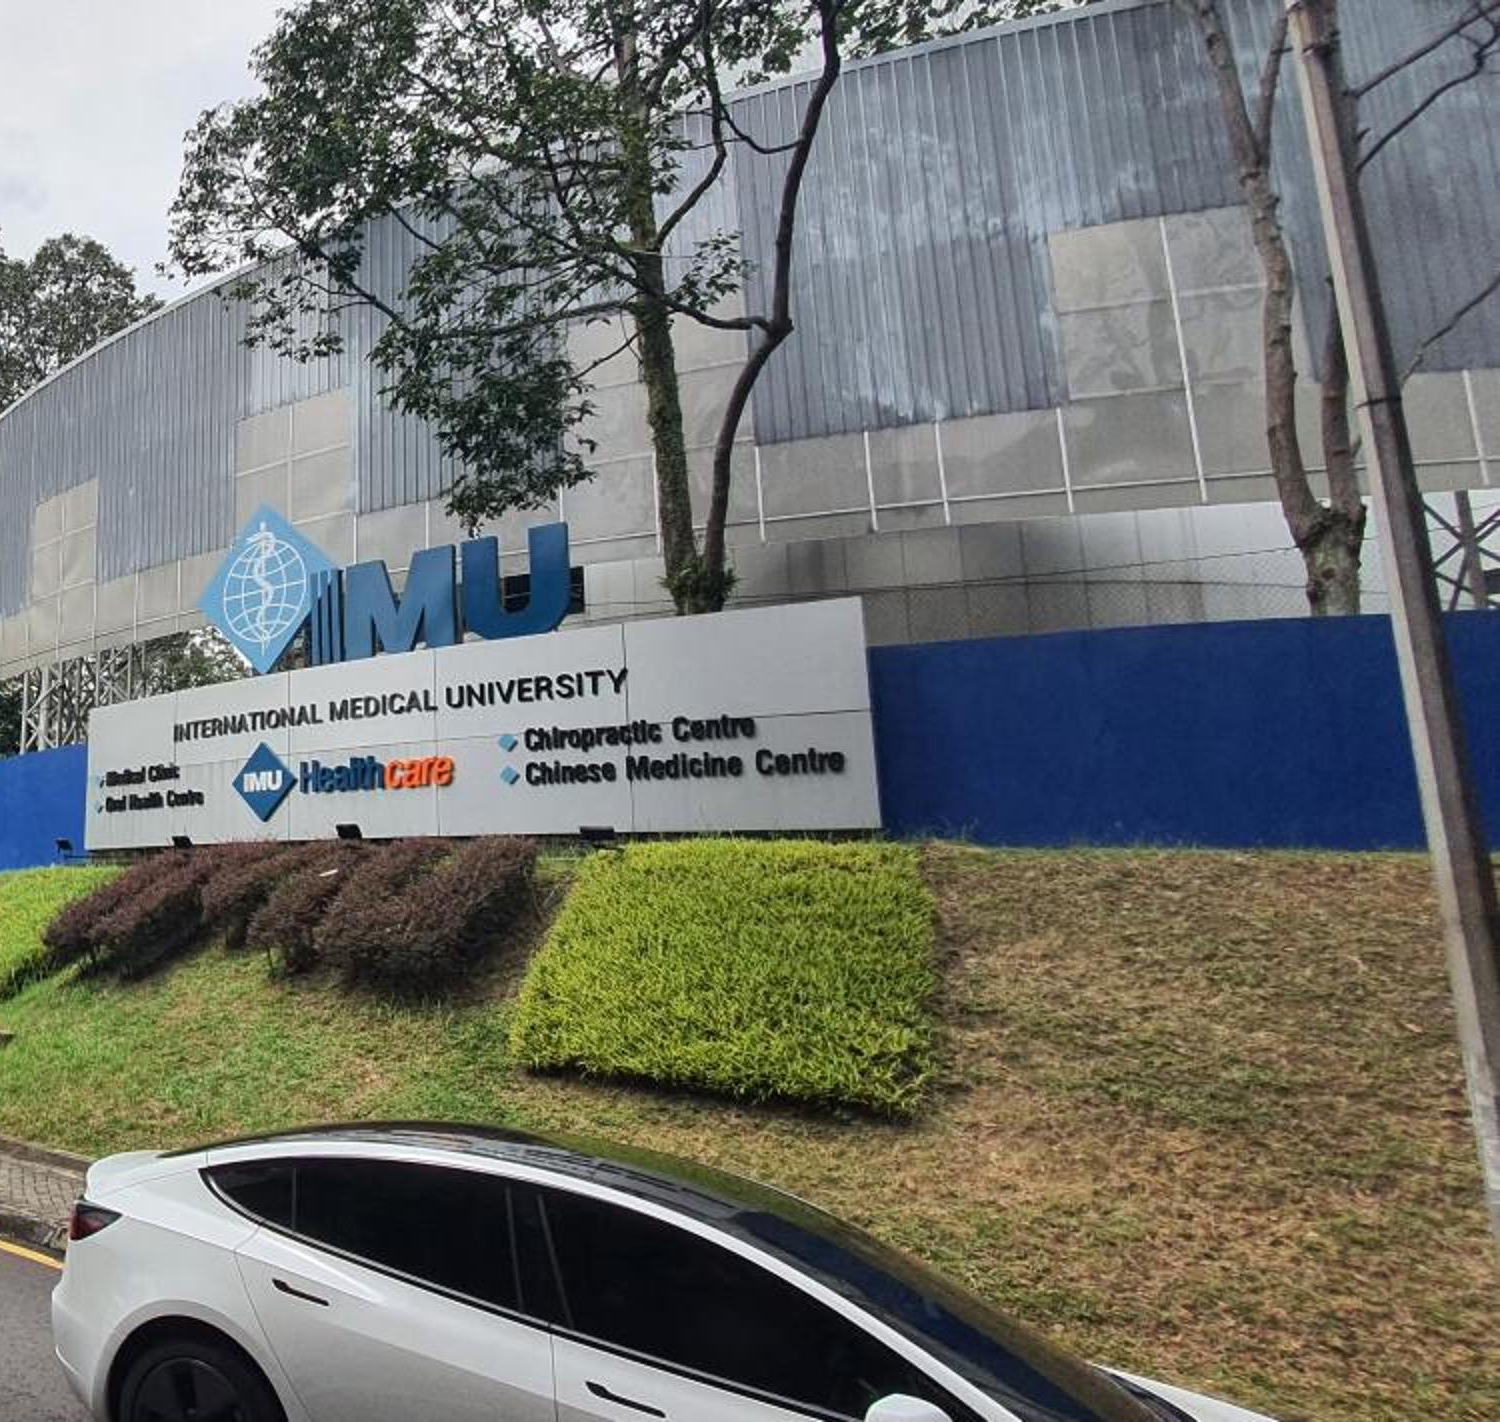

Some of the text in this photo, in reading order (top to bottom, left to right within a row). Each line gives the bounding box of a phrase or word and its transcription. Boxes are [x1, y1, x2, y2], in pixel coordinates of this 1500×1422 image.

[310, 521, 570, 666] IMU
[173, 668, 628, 742] INTERNATIONAL MEDICAL UNIVERSITY
[524, 714, 756, 753] Chiropractic Centre
[106, 762, 180, 787] Medical Clinic
[243, 770, 283, 793] IMU
[525, 747, 846, 787] Chinese Medicine Centre
[129, 791, 164, 811] Health
[166, 789, 204, 808] Centre
